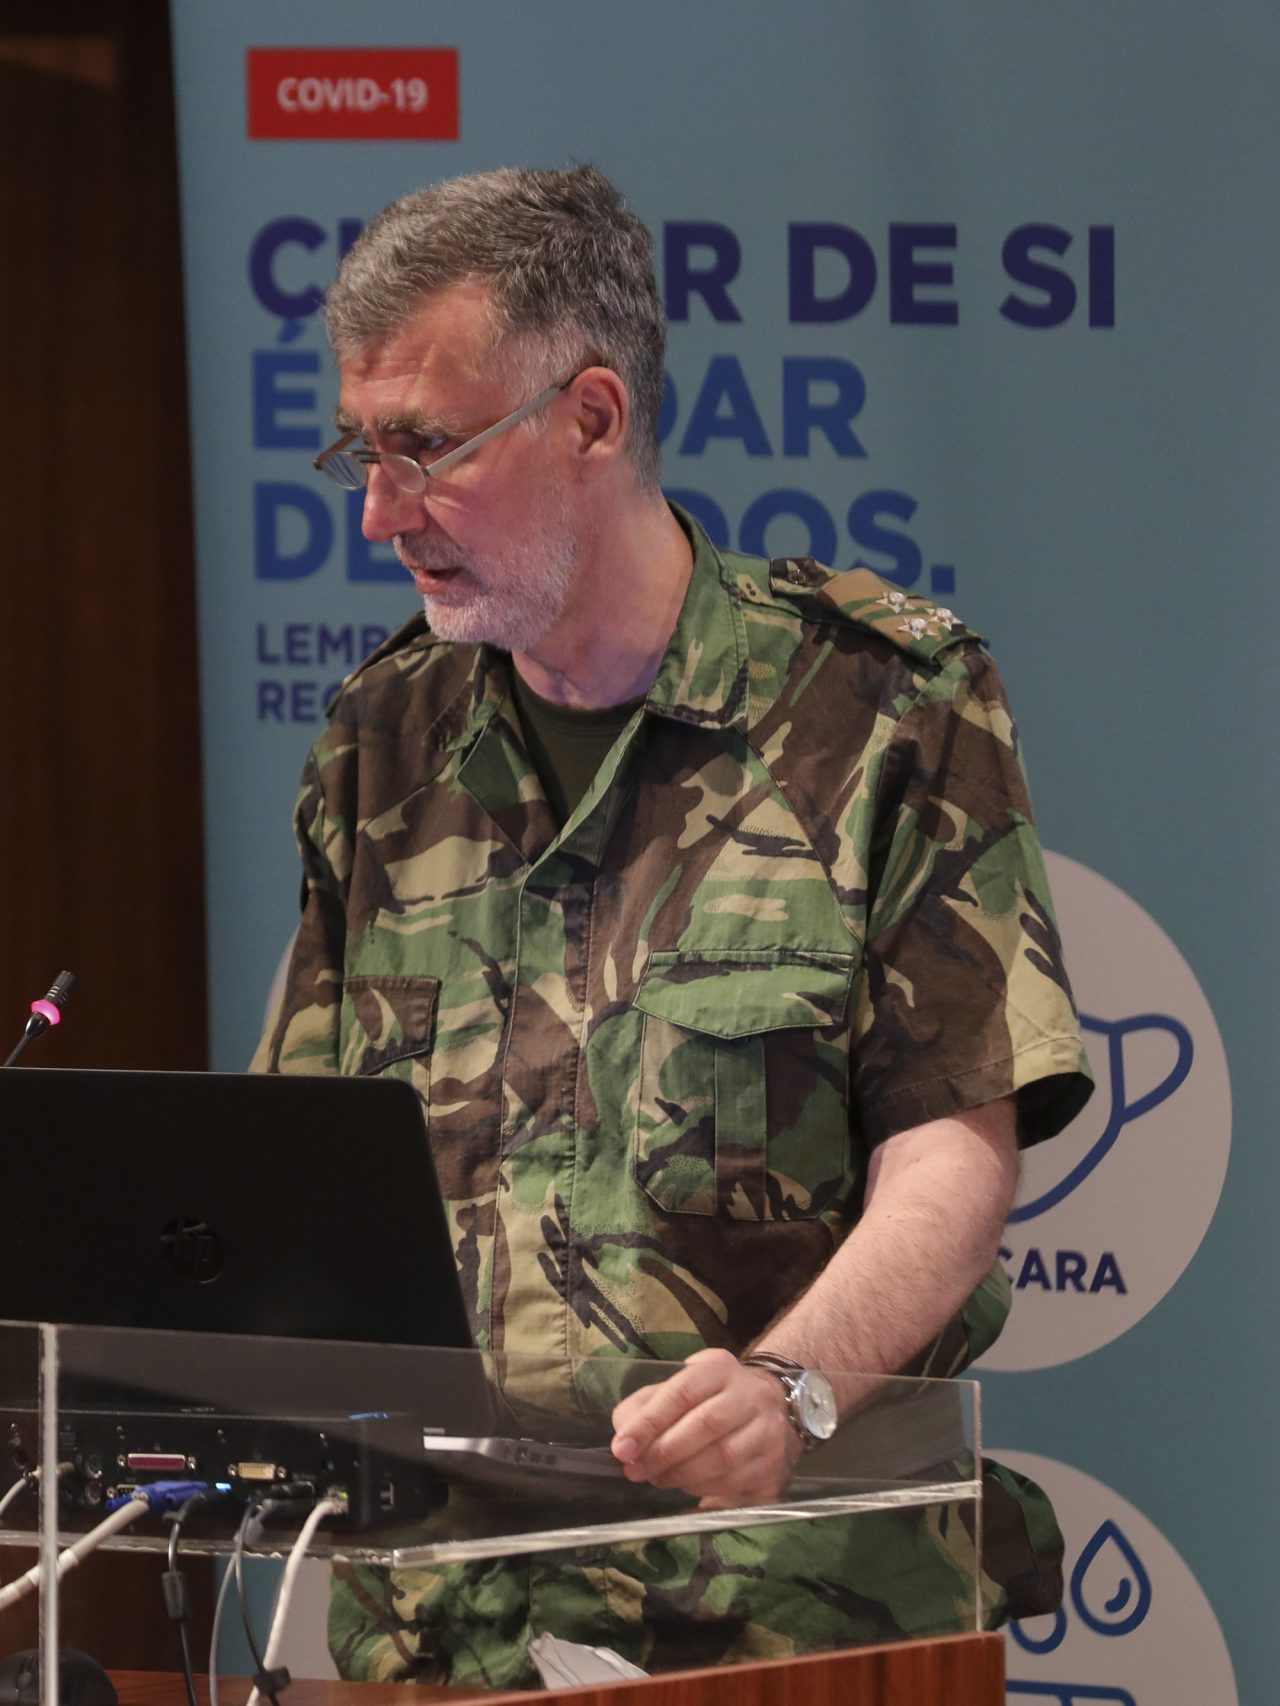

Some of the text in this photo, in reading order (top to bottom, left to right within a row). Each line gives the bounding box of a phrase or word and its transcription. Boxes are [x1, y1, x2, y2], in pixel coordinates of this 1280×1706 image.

[276, 76, 429, 112] COVID-19
[787, 221, 959, 325] DE
[999, 222, 1116, 330] SI
[253, 317, 323, 449] É
[661, 487, 956, 595] OS.
[998, 1246, 1128, 1295] ARA
